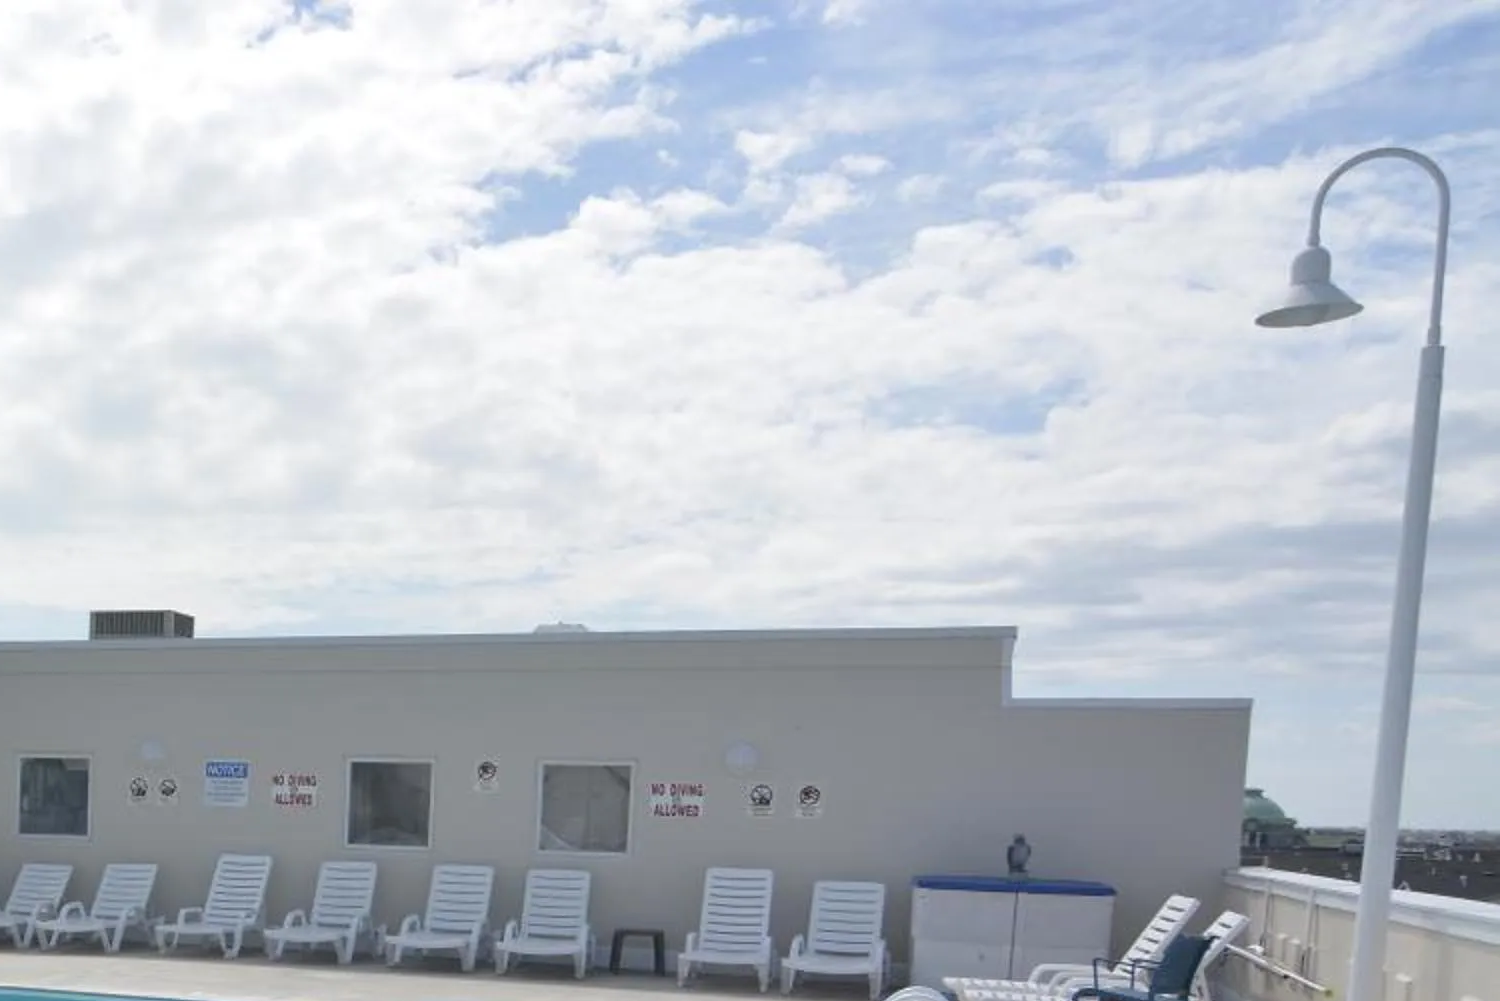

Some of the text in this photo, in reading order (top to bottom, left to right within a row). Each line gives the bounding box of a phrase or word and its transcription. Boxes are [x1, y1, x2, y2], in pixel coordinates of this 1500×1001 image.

[651, 784, 704, 797] NO DIVING
[654, 804, 700, 817] ALLOWED
